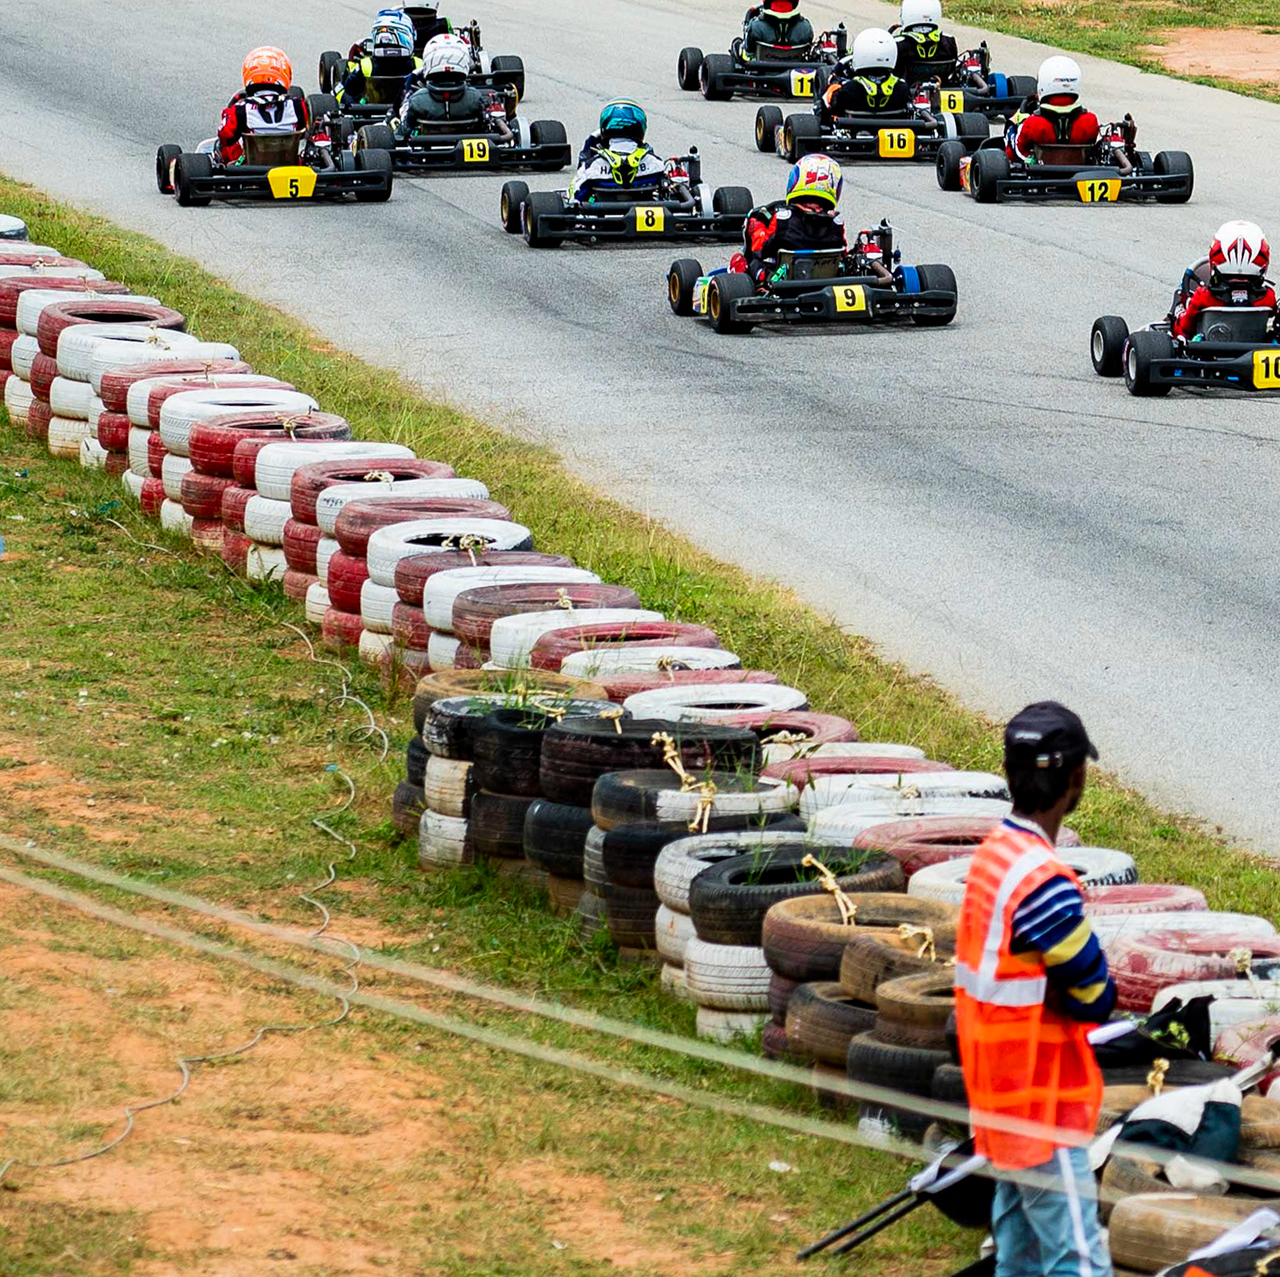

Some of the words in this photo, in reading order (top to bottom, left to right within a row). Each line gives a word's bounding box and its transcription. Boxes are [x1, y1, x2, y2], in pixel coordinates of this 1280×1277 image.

[947, 93, 957, 110] 6
[887, 132, 907, 150] 16
[466, 142, 486, 159] 19
[289, 178, 299, 198] 5
[1087, 182, 1109, 202] 12
[645, 209, 656, 227] 8
[844, 288, 856, 307] 9
